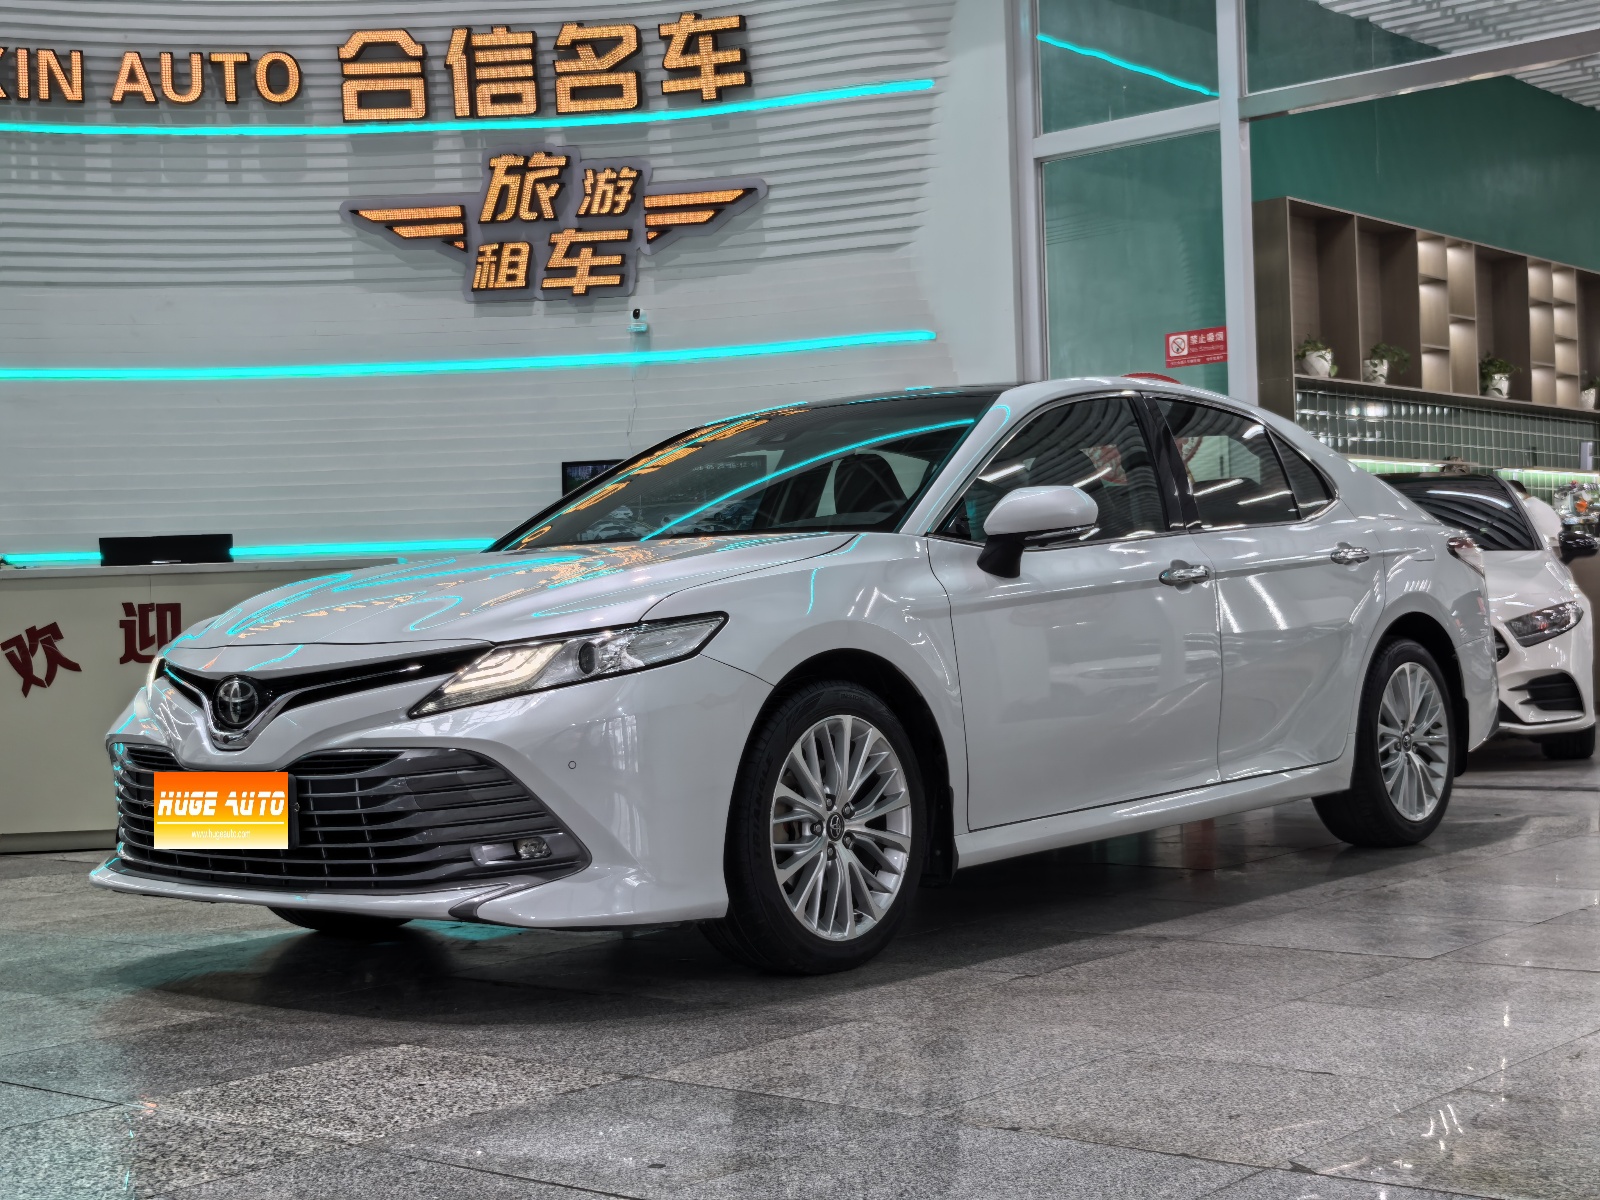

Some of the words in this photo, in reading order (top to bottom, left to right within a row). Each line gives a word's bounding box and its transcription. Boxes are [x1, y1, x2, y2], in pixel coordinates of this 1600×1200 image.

[110, 51, 302, 104] AUTO
[337, 12, 750, 121] 合信名车
[478, 151, 642, 223] 旅游
[471, 228, 632, 296] 租车
[1189, 332, 1224, 345] 禁止吸烟
[752, 750, 774, 860] TRIANGLE
